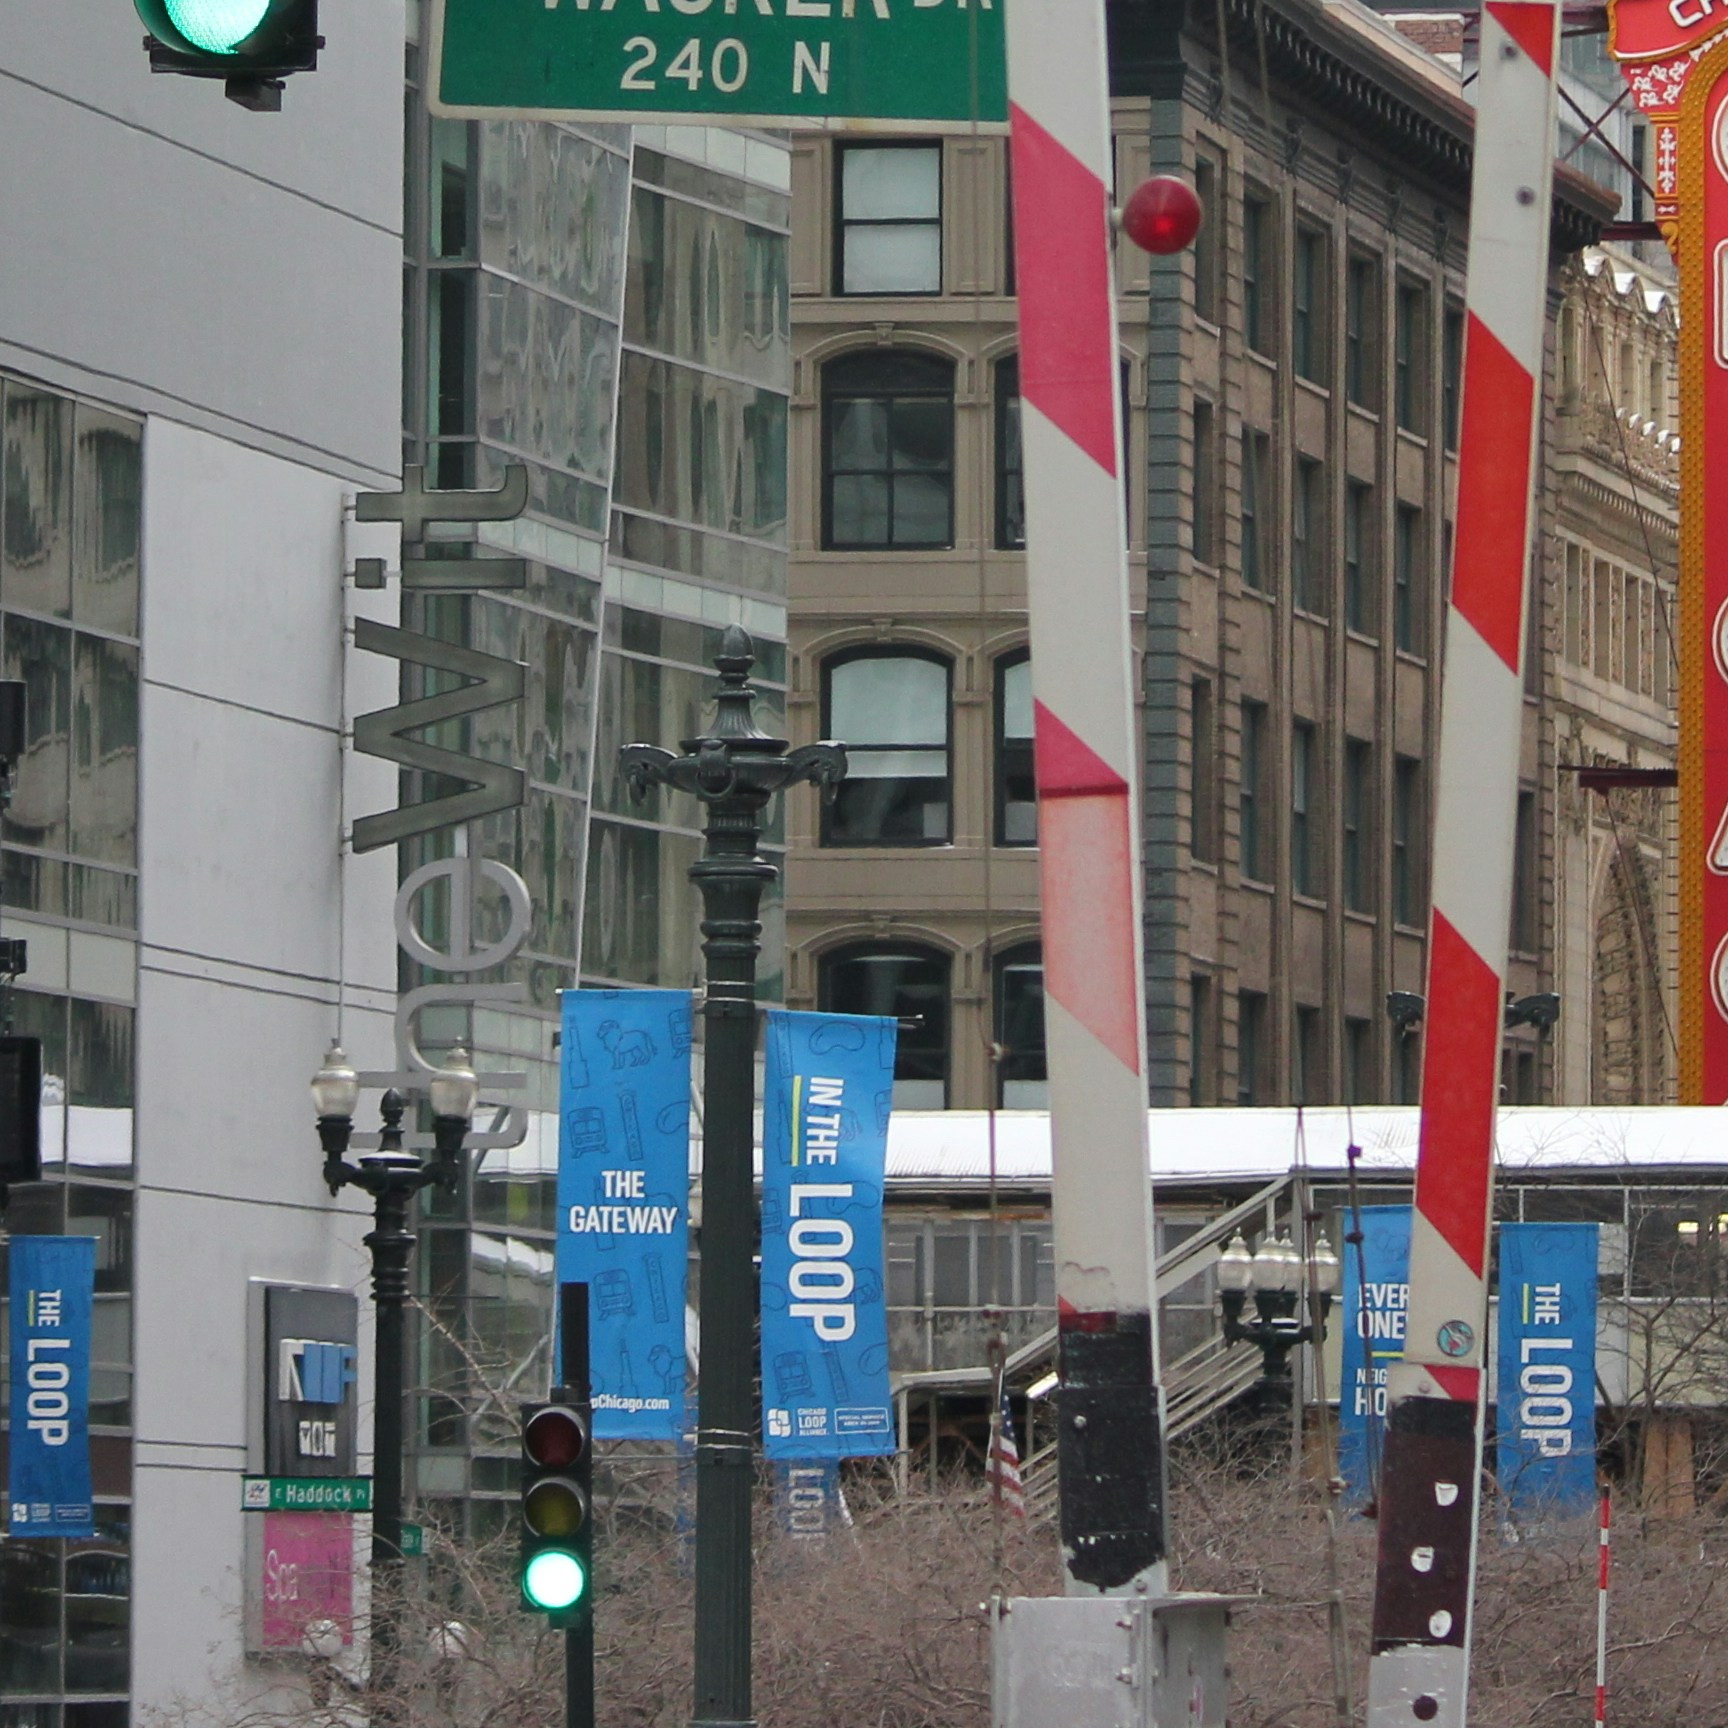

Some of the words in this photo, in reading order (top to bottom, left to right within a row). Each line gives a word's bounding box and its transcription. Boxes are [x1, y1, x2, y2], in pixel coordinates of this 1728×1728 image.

[621, 36, 749, 93] 240
[792, 41, 831, 95] N
[809, 1077, 844, 1106] IN
[806, 1114, 840, 1165] THE
[602, 1171, 645, 1198] THE
[570, 1206, 678, 1234] GATEWAY
[788, 1184, 856, 1342] LOOP
[38, 1290, 63, 1327] THE
[1359, 1284, 1409, 1309] EVER
[1534, 1283, 1561, 1325] THE
[1357, 1311, 1408, 1339] ONE
[1357, 1369, 1387, 1384] NEIG
[27, 1339, 70, 1446] LOOP
[1355, 1388, 1387, 1415] HO
[1520, 1338, 1574, 1458] LOOP
[798, 1416, 826, 1428] LOOP
[275, 1488, 282, 1499] E
[286, 1484, 351, 1503] Haddock
